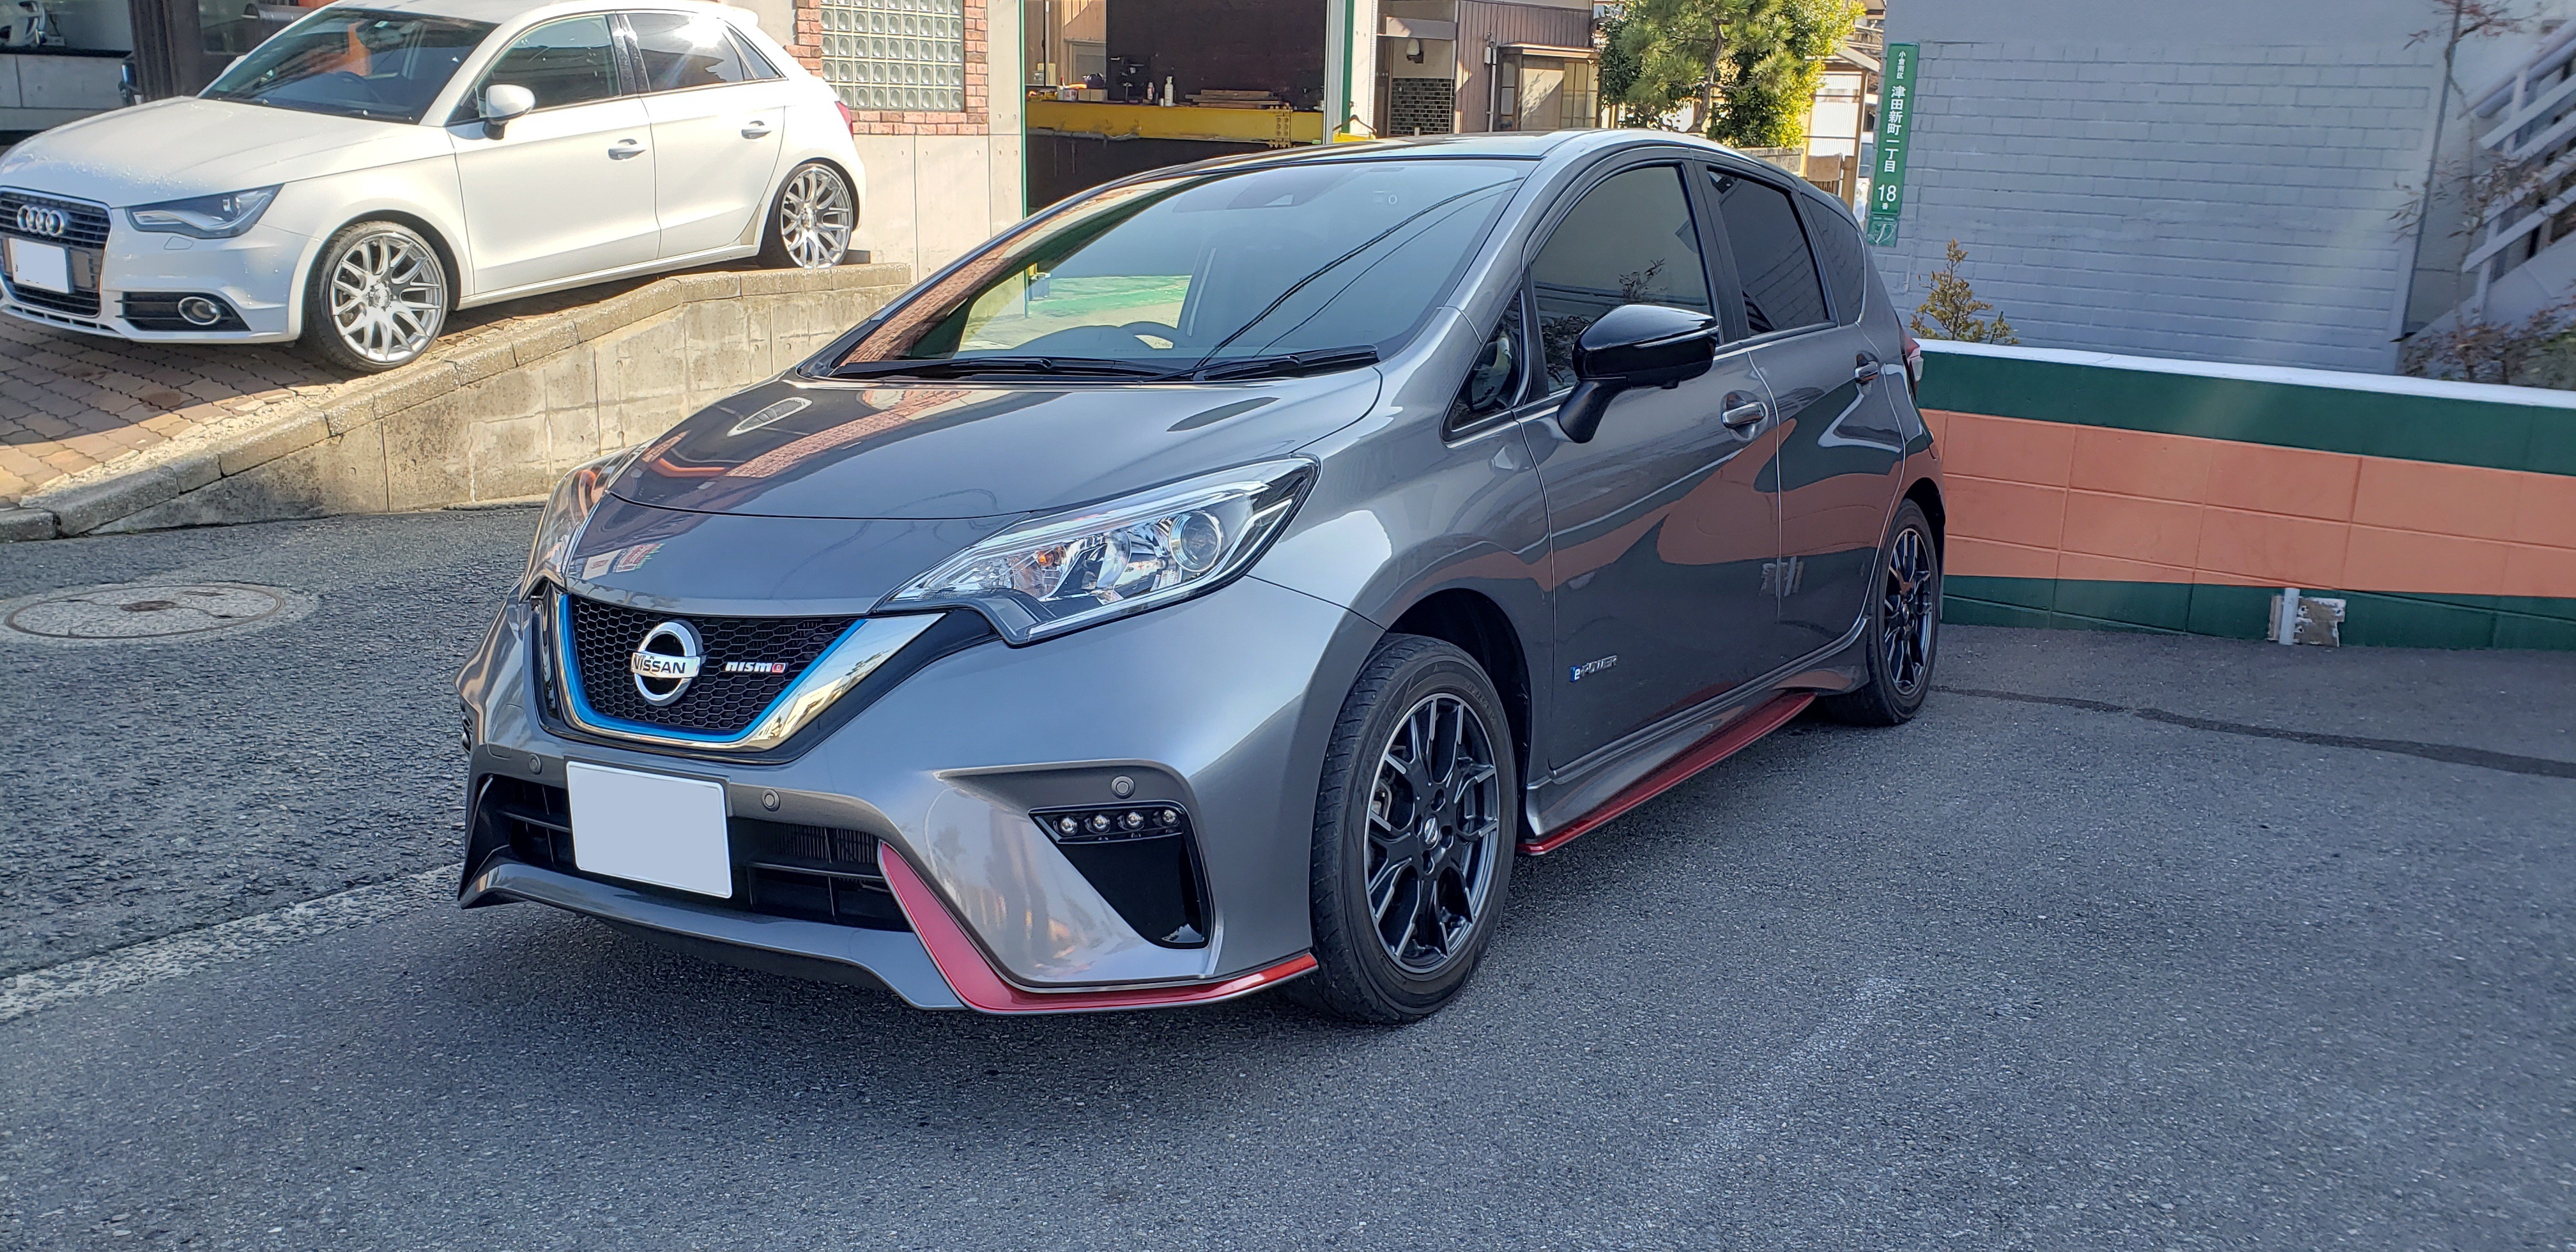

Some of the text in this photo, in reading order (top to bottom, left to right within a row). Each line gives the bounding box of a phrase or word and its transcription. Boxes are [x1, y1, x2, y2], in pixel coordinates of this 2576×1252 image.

[1884, 86, 1906, 173] 津田新町一丁目
[633, 654, 686, 674] NISSAN
